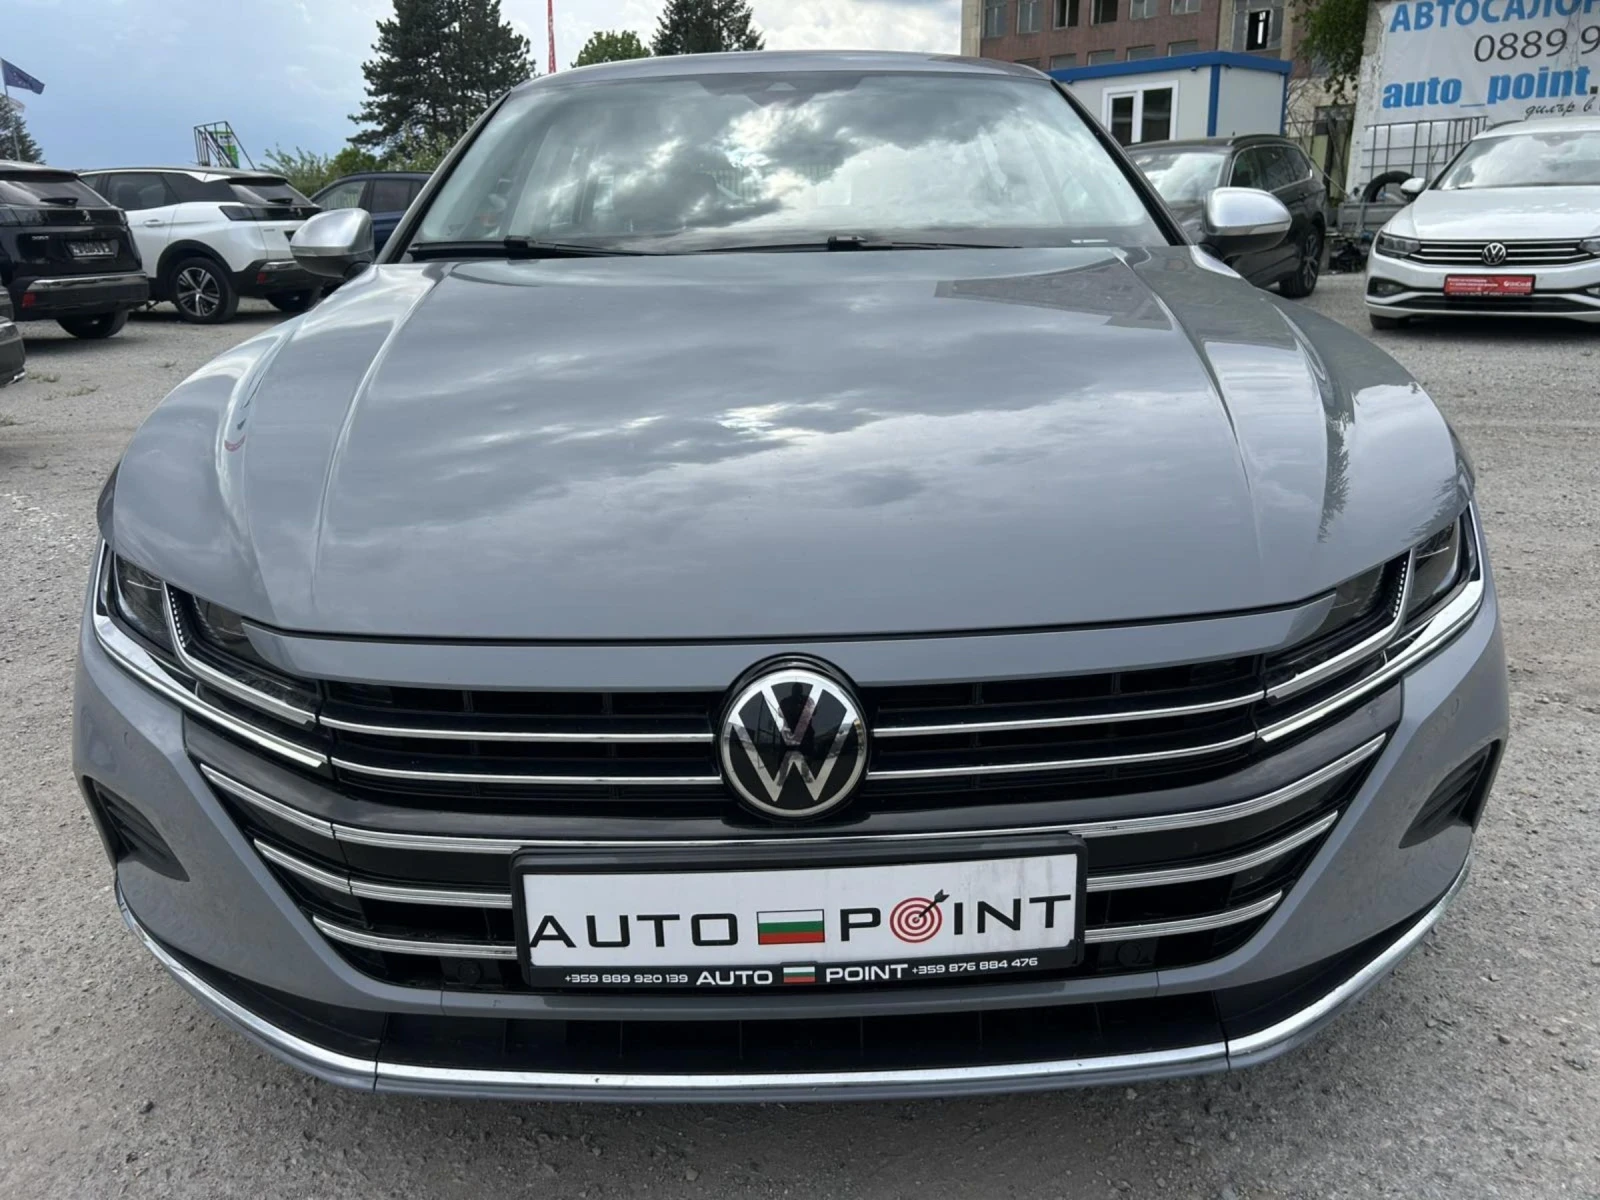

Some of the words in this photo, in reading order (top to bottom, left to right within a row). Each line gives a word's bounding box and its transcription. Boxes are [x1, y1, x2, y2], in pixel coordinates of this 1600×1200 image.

[1474, 28, 1568, 62] 0889
[721, 669, 867, 817] VW
[530, 913, 739, 948] AUTO
[564, 973, 599, 983] +359
[602, 973, 631, 983] 889
[634, 973, 663, 983] 920
[666, 973, 689, 983] 139
[696, 970, 773, 986] AUTO
[826, 964, 909, 982] POINT
[911, 964, 946, 975] +359
[949, 962, 976, 972] 876
[979, 959, 1008, 970] 884
[1011, 957, 1039, 967] 476
